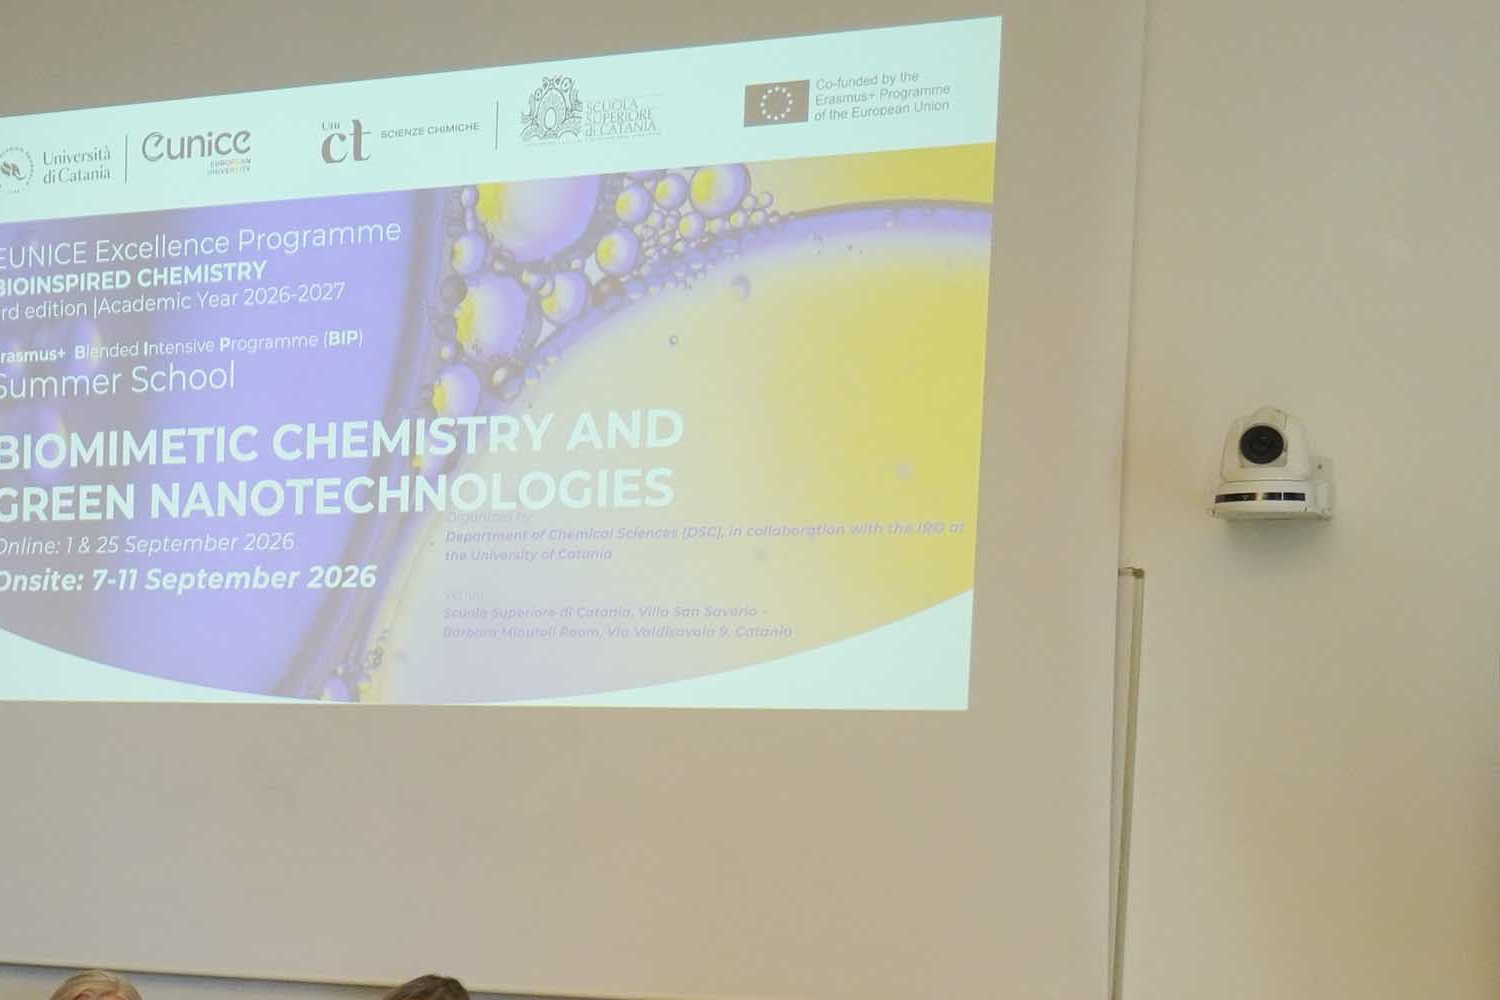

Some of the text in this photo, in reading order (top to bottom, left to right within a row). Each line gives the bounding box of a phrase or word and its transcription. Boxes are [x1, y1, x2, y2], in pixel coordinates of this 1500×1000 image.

[815, 72, 919, 91] Co-funded by the
[815, 84, 950, 106] Erasmus+ Programme
[814, 100, 949, 121] of the European Union
[380, 122, 480, 139] SCIENZE CHIMICHE
[42, 144, 112, 166] Università
[58, 163, 112, 183] Catania
[96, 234, 229, 262] Excellence
[239, 222, 401, 256] Programme
[137, 261, 268, 288] CHEMISTRY
[25, 299, 87, 320] edition
[196, 290, 239, 310] Year
[244, 282, 346, 305] 2026-2027
[75, 341, 139, 361] Blended
[144, 339, 214, 357] Intensive
[220, 332, 319, 355] Programme
[323, 328, 364, 349] (BIP)
[131, 360, 236, 393] School
[272, 413, 553, 463] CHEMISTRY
[565, 409, 684, 452] AND
[150, 466, 675, 520] NANOTECHNOLOGIES
[77, 536, 92, 554] &
[96, 535, 120, 555] 25
[125, 532, 237, 558] September
[243, 531, 295, 552] 2026
[446, 529, 527, 545] Department
[616, 526, 677, 540] Sciences
[746, 523, 845, 538] collaboration
[558, 547, 613, 561] Catania
[92, 569, 138, 592] 7-11
[145, 565, 300, 597] September
[308, 565, 377, 588] 2026
